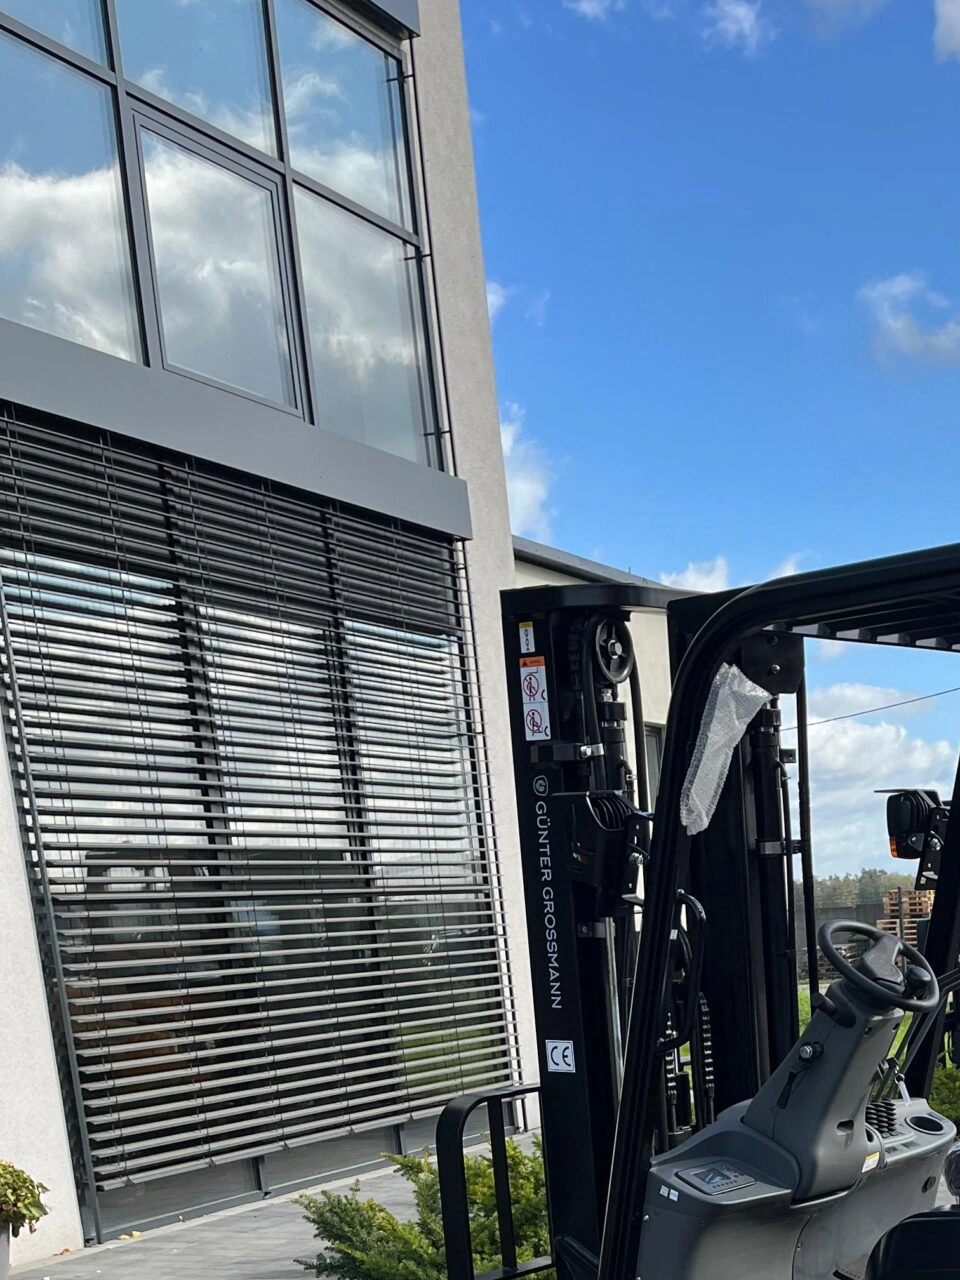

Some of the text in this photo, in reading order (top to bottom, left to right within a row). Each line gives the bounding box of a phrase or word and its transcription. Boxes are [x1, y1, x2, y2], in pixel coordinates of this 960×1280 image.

[535, 801, 562, 1009] GÜNTER GROSSMANN
[550, 1045, 571, 1067] CE
